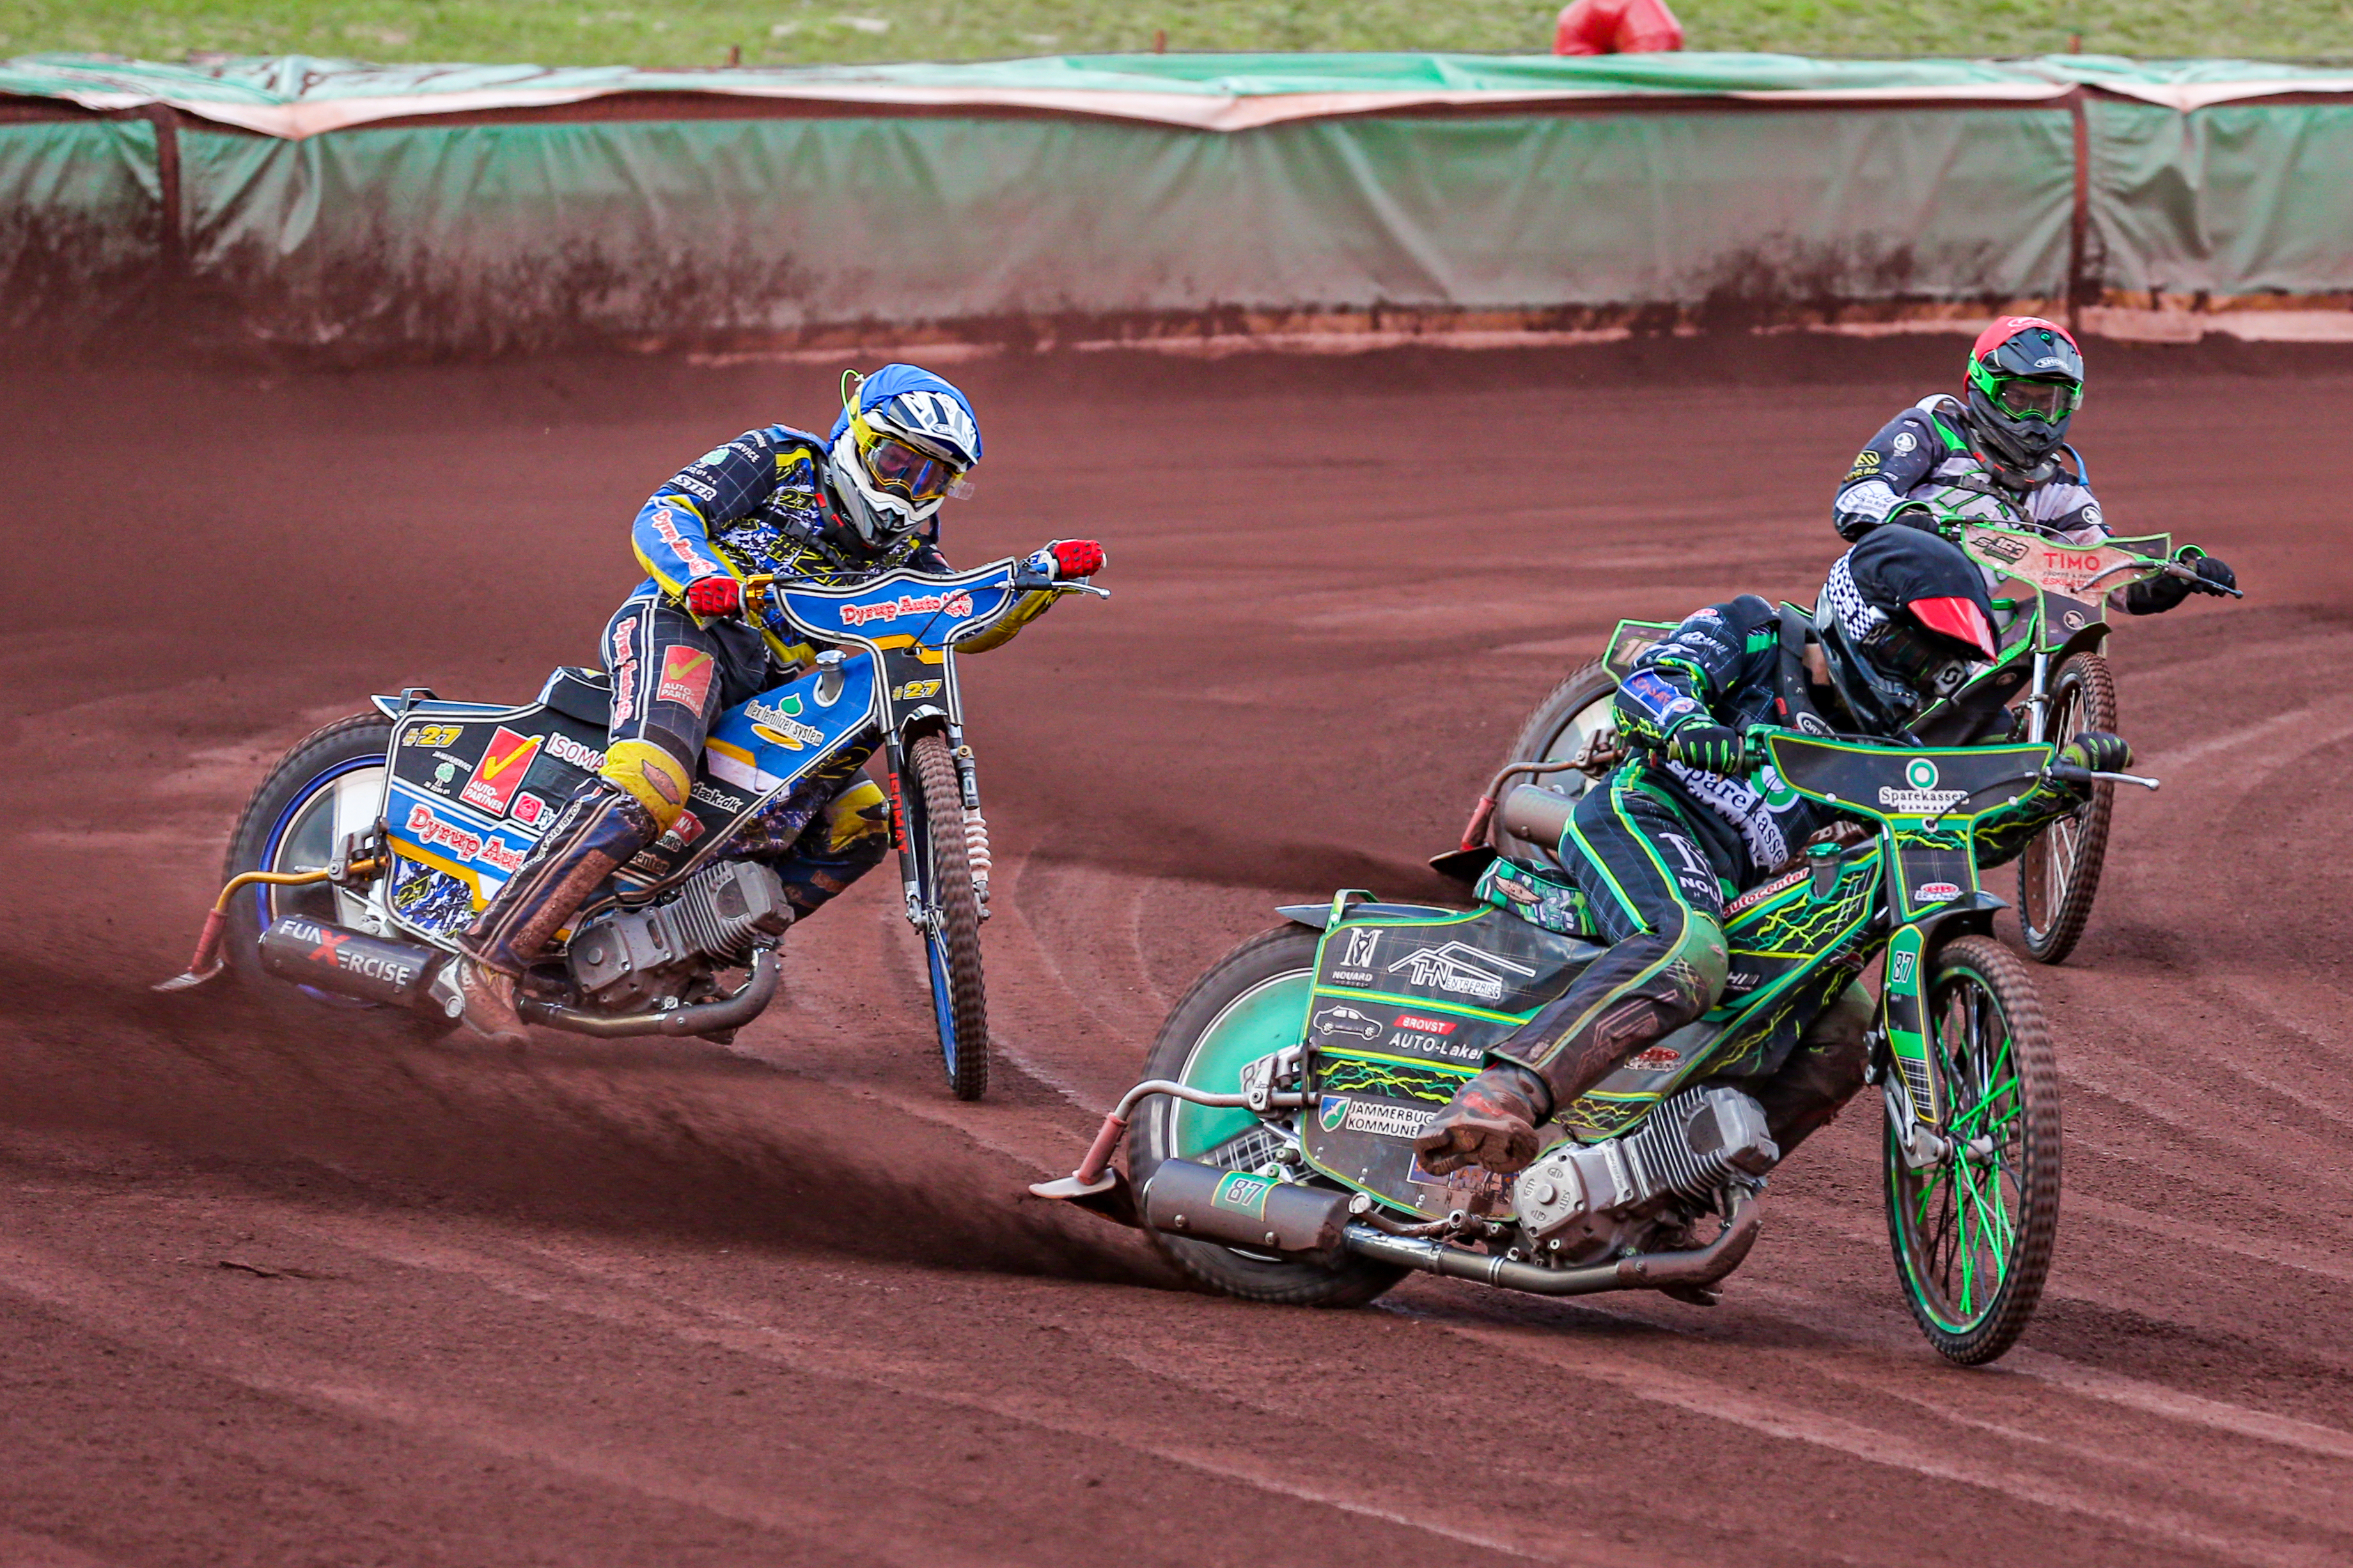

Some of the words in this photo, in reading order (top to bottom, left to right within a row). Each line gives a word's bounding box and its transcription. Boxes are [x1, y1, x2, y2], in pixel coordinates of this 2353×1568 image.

[2043, 552, 2100, 571] TIMO
[841, 602, 896, 624] Dyrup
[900, 596, 942, 614] Auto
[892, 679, 942, 701] #27
[746, 699, 760, 719] flex
[762, 705, 793, 734] fertilizer
[793, 724, 824, 745] system
[402, 725, 464, 747] #27
[470, 780, 498, 796] AUTO-
[465, 788, 504, 812] PARTNER
[409, 807, 480, 859] Dyrup
[398, 876, 431, 907] 27
[1723, 867, 1810, 917] autocenter
[1331, 970, 1373, 982] NOUARD
[1893, 951, 1916, 983] 87
[1446, 977, 1501, 995] ENTREPRISE
[1402, 1016, 1445, 1032] BROVST
[1348, 1119, 1418, 1138] KOMMUNE
[1225, 1178, 1265, 1206] 87
